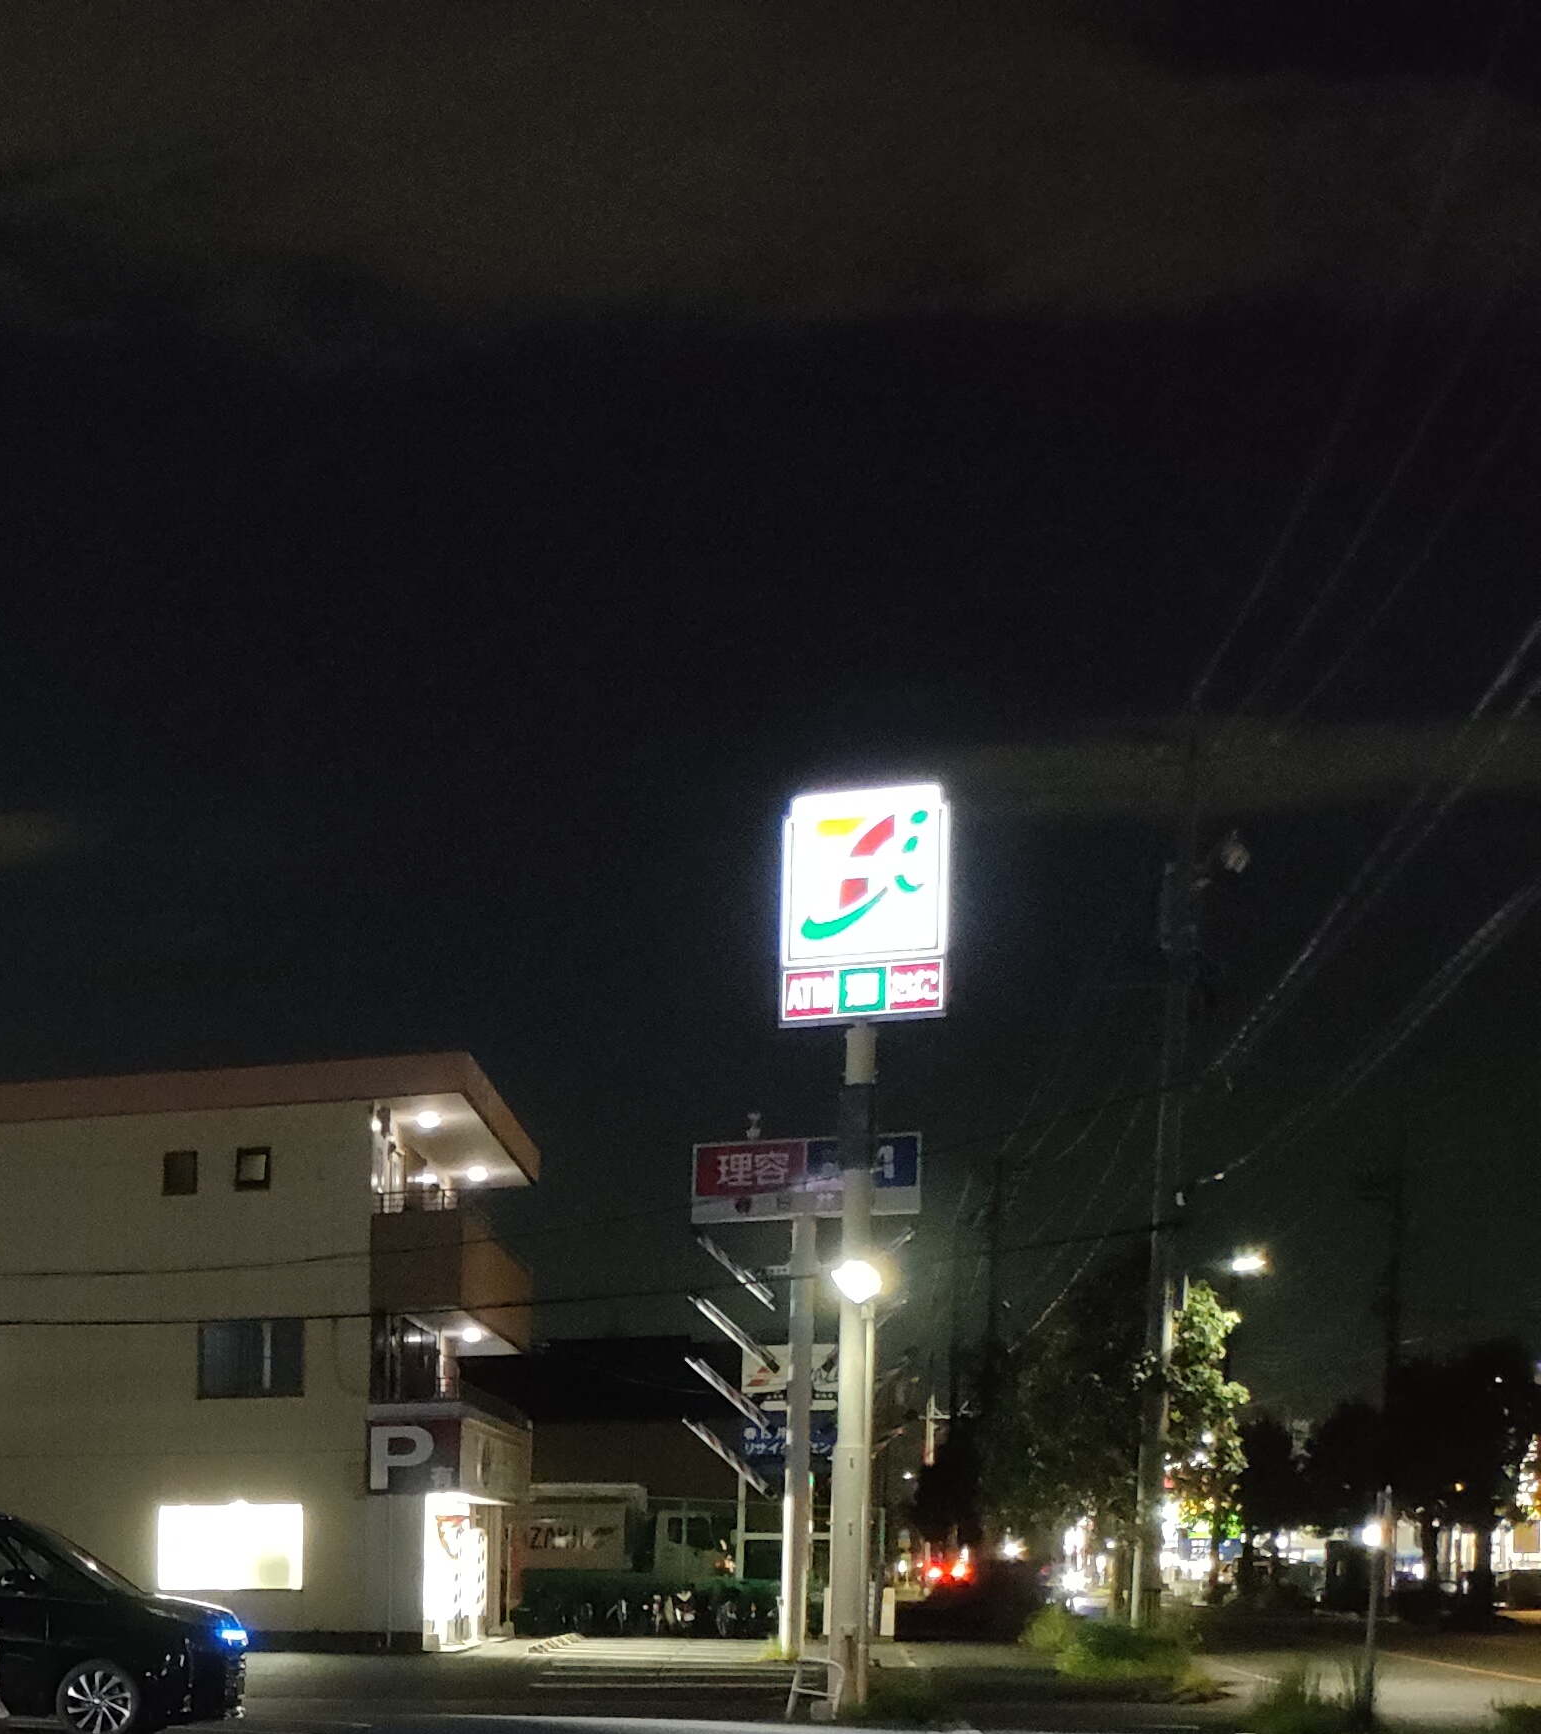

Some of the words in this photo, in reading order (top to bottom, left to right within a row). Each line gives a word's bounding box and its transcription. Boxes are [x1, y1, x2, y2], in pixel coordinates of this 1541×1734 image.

[787, 976, 834, 1009] ATM
[717, 1151, 789, 1187] 理容
[370, 1425, 435, 1490] P
